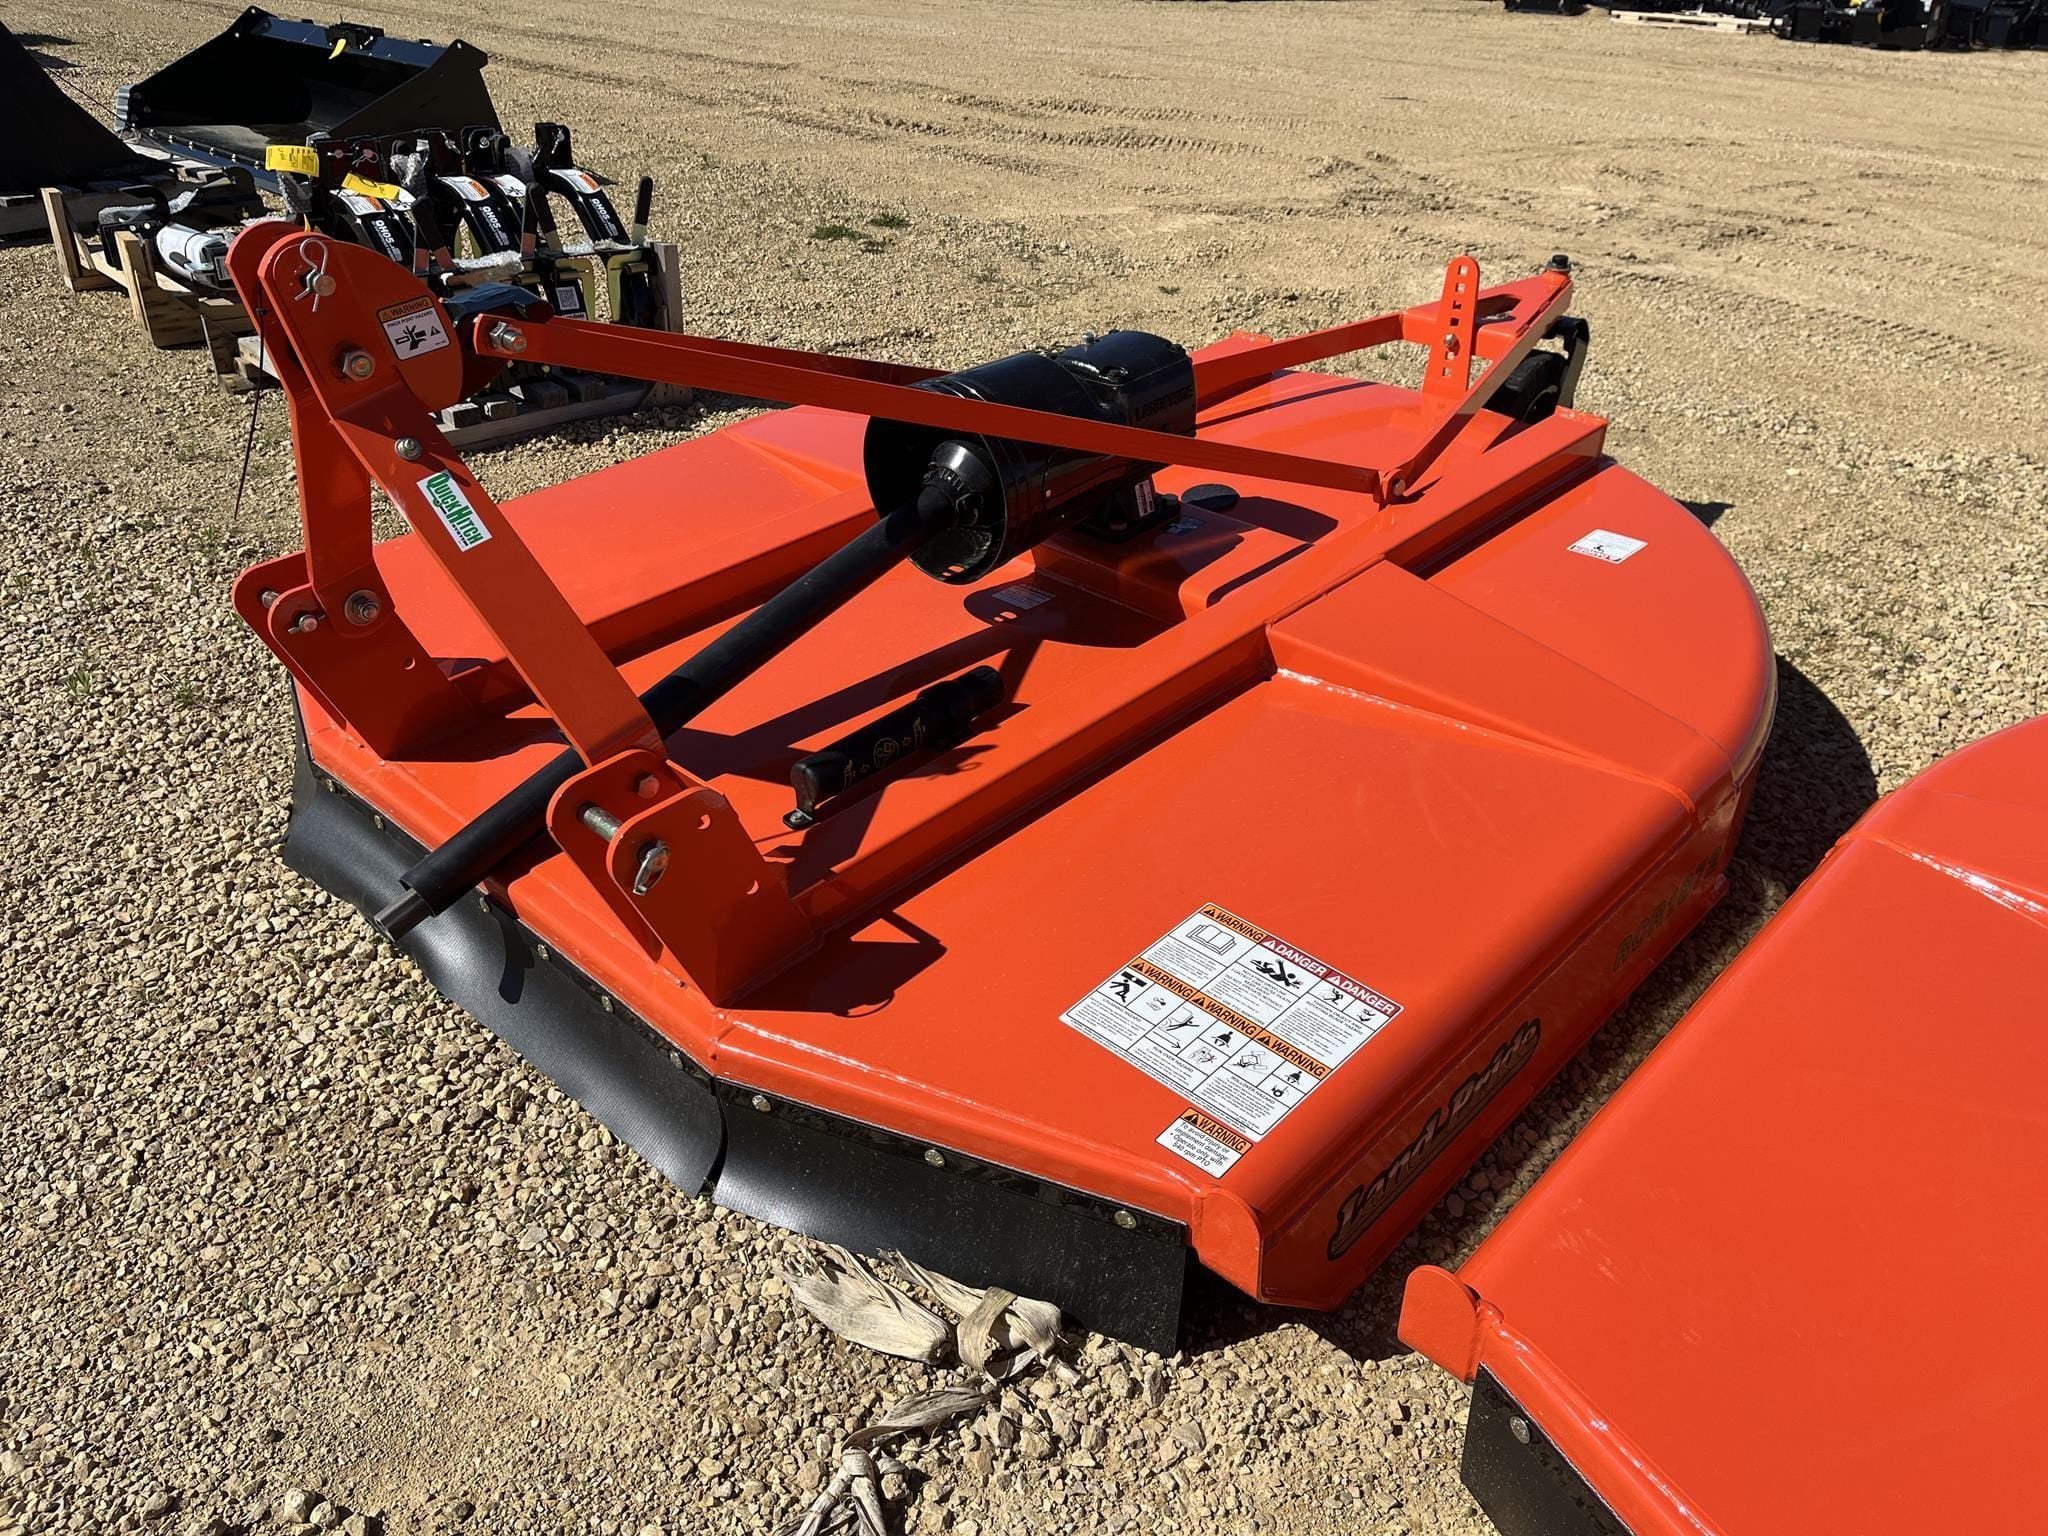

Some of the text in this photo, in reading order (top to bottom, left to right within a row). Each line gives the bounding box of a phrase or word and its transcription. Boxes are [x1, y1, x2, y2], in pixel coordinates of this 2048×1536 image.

[375, 219, 395, 244] QH05
[391, 299, 429, 317] WARNING
[401, 315, 415, 324] POINT
[415, 310, 434, 319] HAZARD
[1214, 911, 1265, 941] WARNING
[1272, 943, 1328, 976] DANGER
[1142, 966, 1194, 998] WARNING
[1338, 979, 1396, 1014] DANGER
[1203, 1001, 1258, 1035] WARNING
[1269, 1040, 1326, 1076] WARNING
[1172, 1134, 1224, 1166] Operate only with
[1173, 1127, 1205, 1147] implement
[1179, 1121, 1189, 1129] To
[1187, 1126, 1206, 1139] avoid
[1203, 1136, 1223, 1150] injury
[1195, 1117, 1248, 1151] WARNING
[1332, 1110, 1442, 1252] Land
[1447, 1018, 1541, 1130] Pride
[1171, 1141, 1211, 1167] 540 rpm PTO
